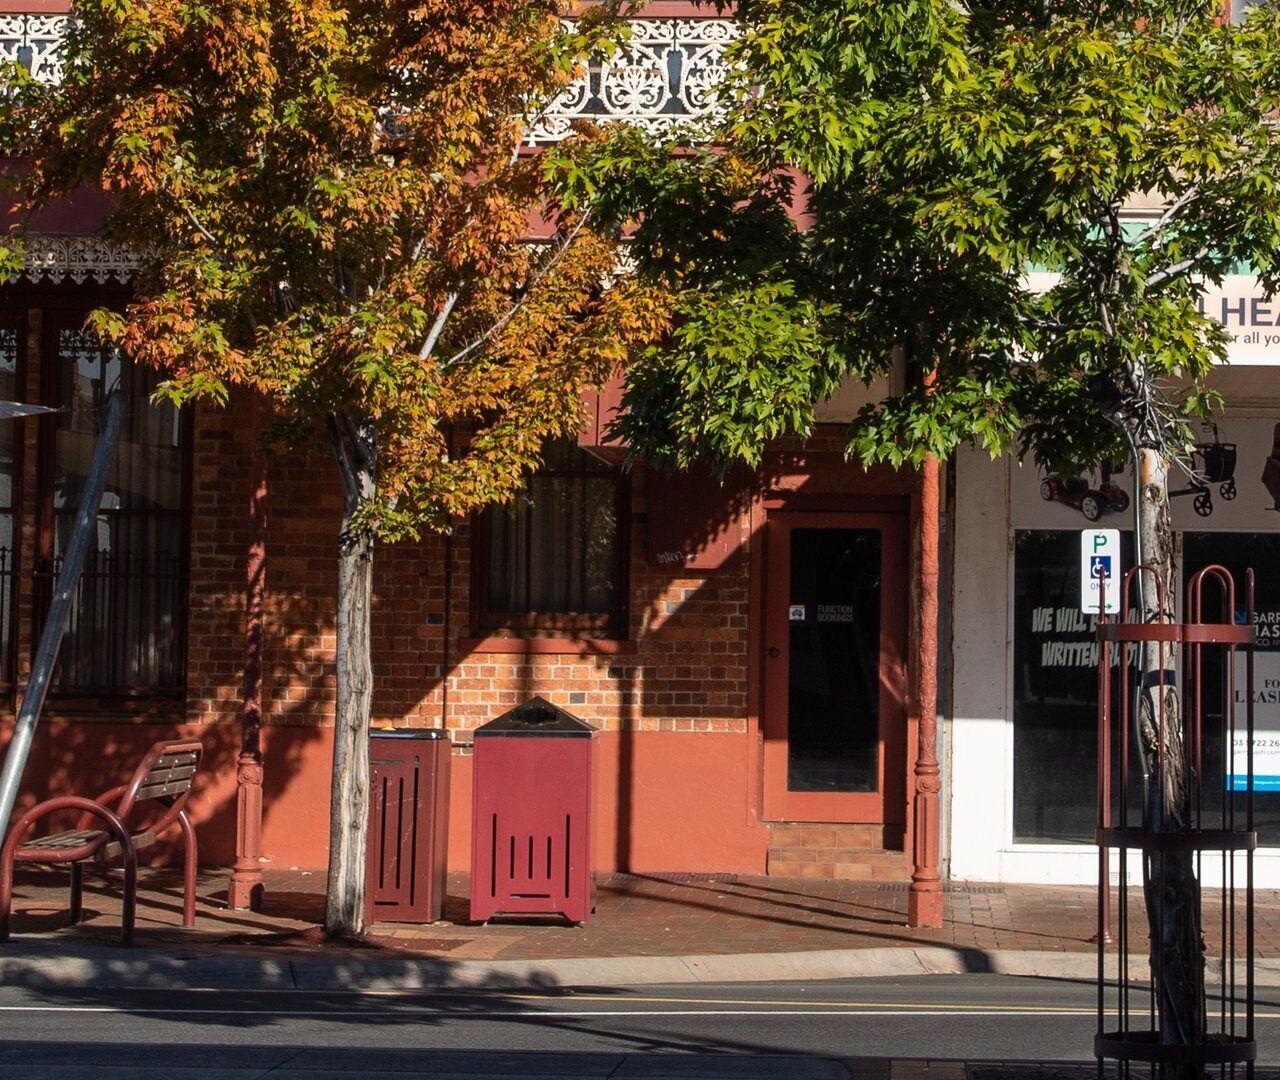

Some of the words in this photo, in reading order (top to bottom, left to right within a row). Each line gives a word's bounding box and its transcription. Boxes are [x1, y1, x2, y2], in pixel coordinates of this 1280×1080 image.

[1243, 331, 1260, 345] all
[1094, 535, 1108, 554] P
[1091, 582, 1111, 591] ONY
[817, 605, 854, 614] FUNCTION
[817, 613, 854, 622] BOOKINGS
[1031, 606, 1054, 632] WE
[1056, 606, 1087, 632] WILL
[1040, 641, 1099, 668] WRITTEN
